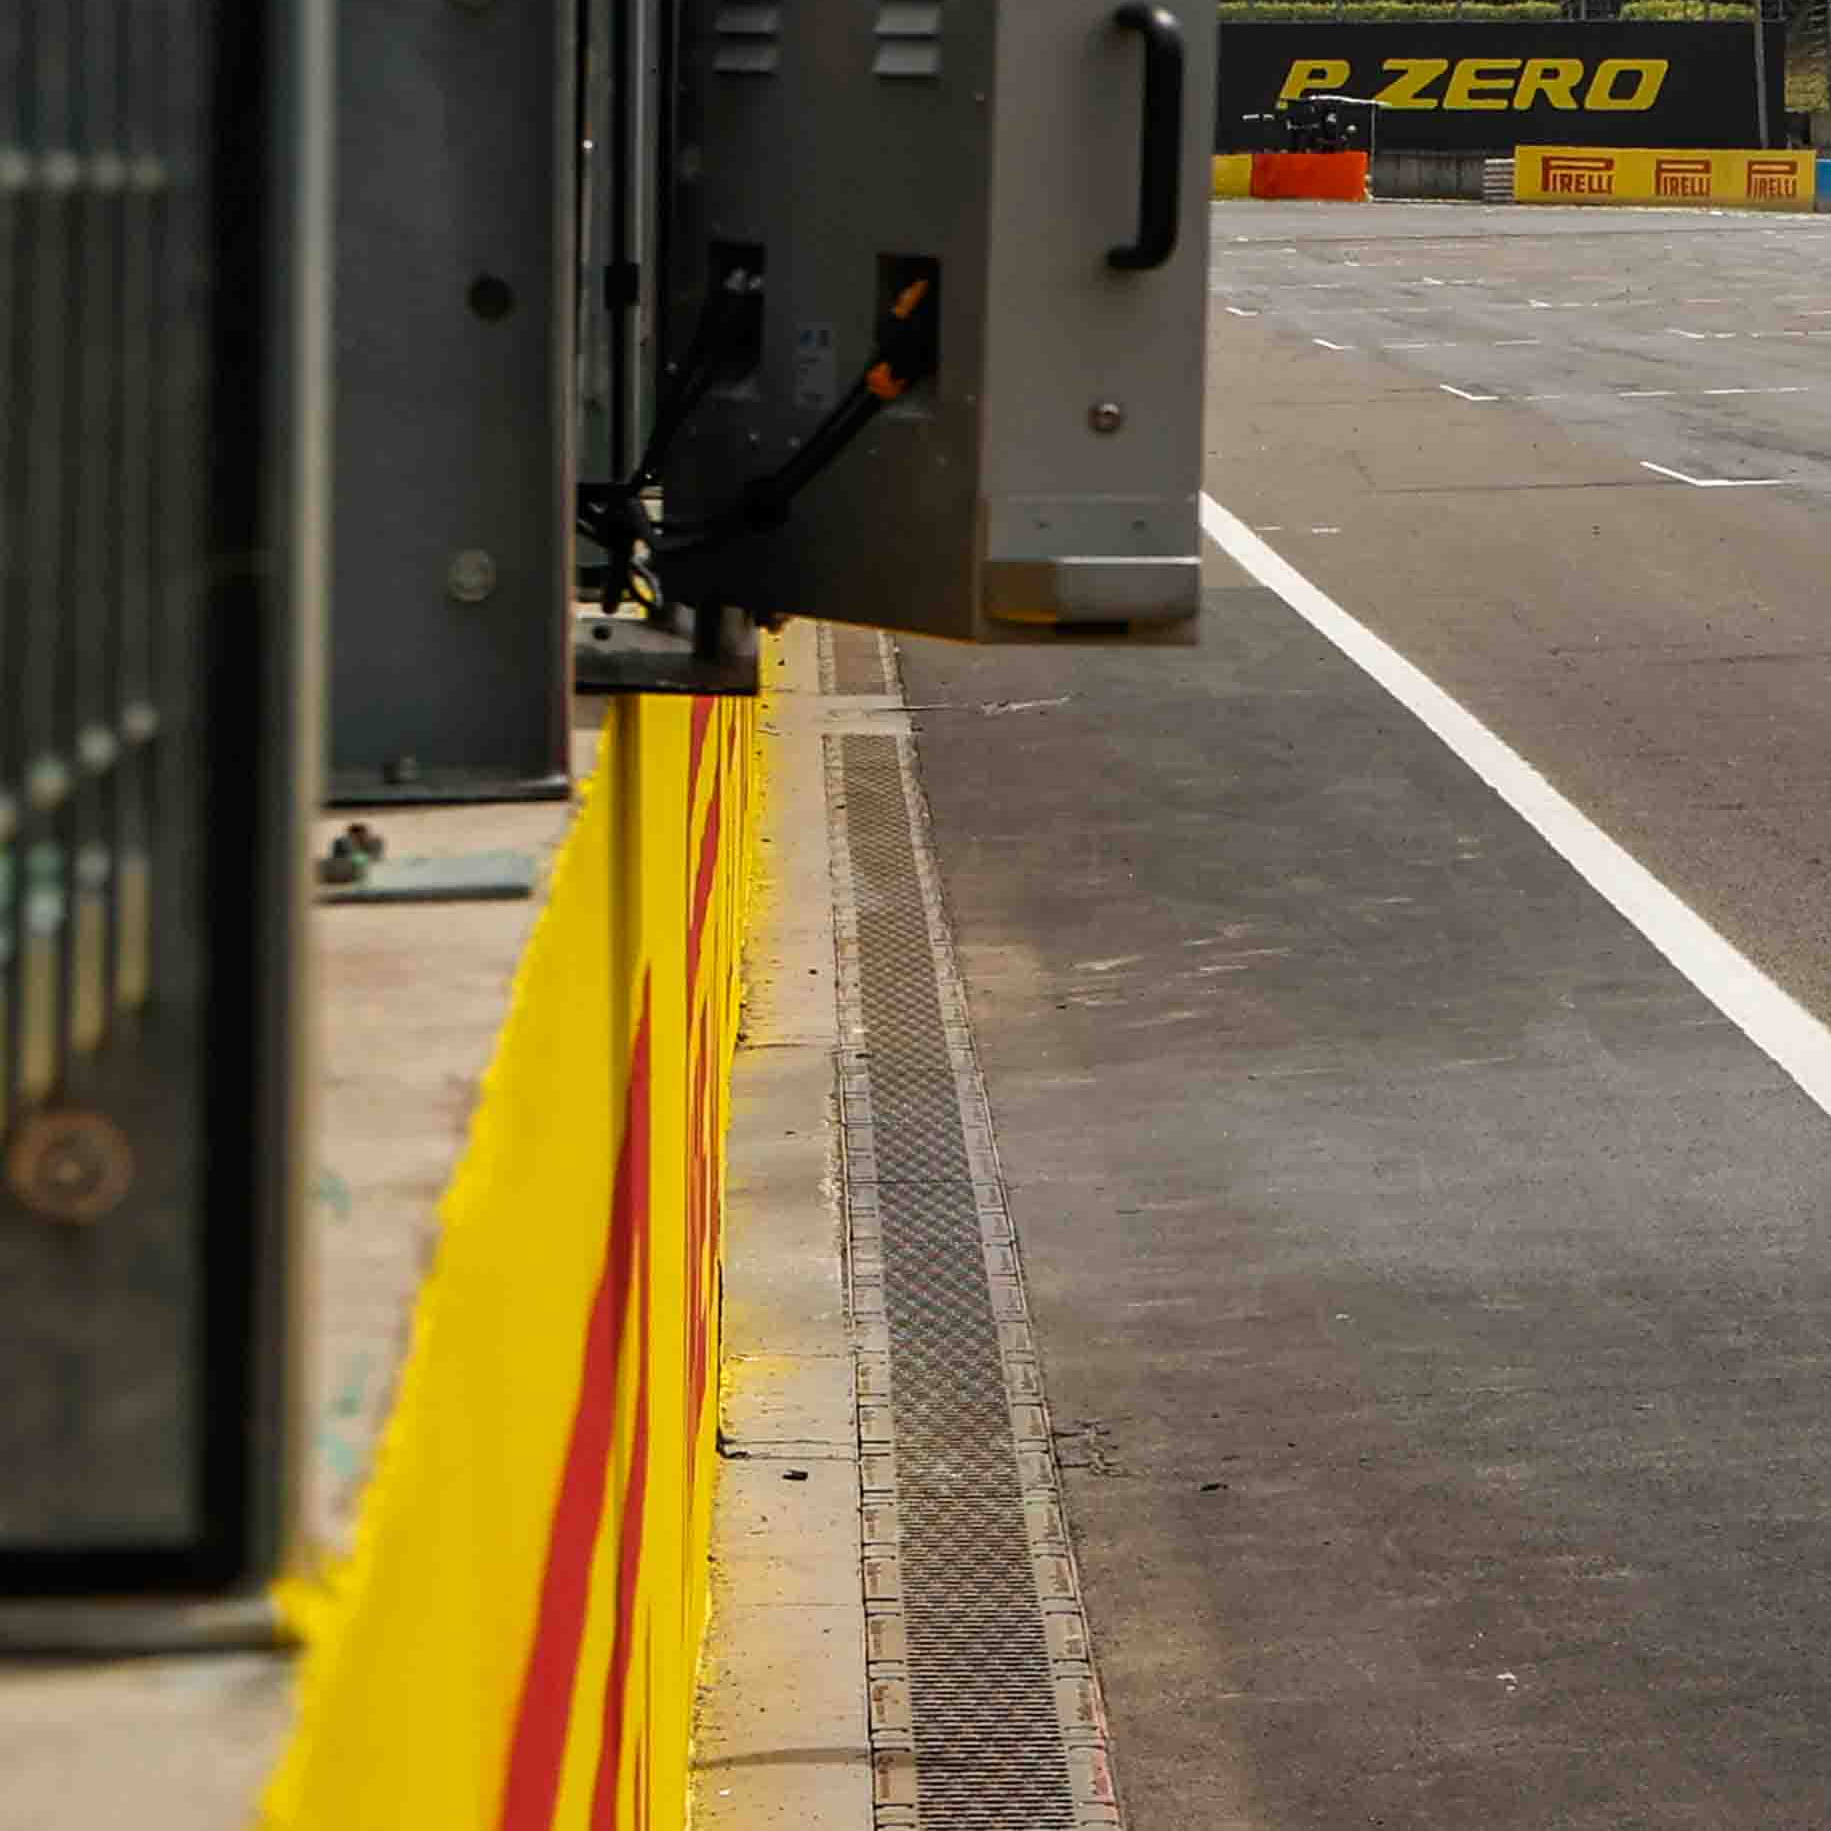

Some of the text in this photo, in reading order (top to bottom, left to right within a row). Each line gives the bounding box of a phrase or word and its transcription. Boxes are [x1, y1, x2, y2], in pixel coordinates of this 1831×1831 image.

[1276, 59, 1669, 111] P ZERO
[1541, 155, 1613, 194] PIRELLI
[1654, 158, 1712, 197] PIRELLI
[1746, 159, 1798, 199] PIRELLI
